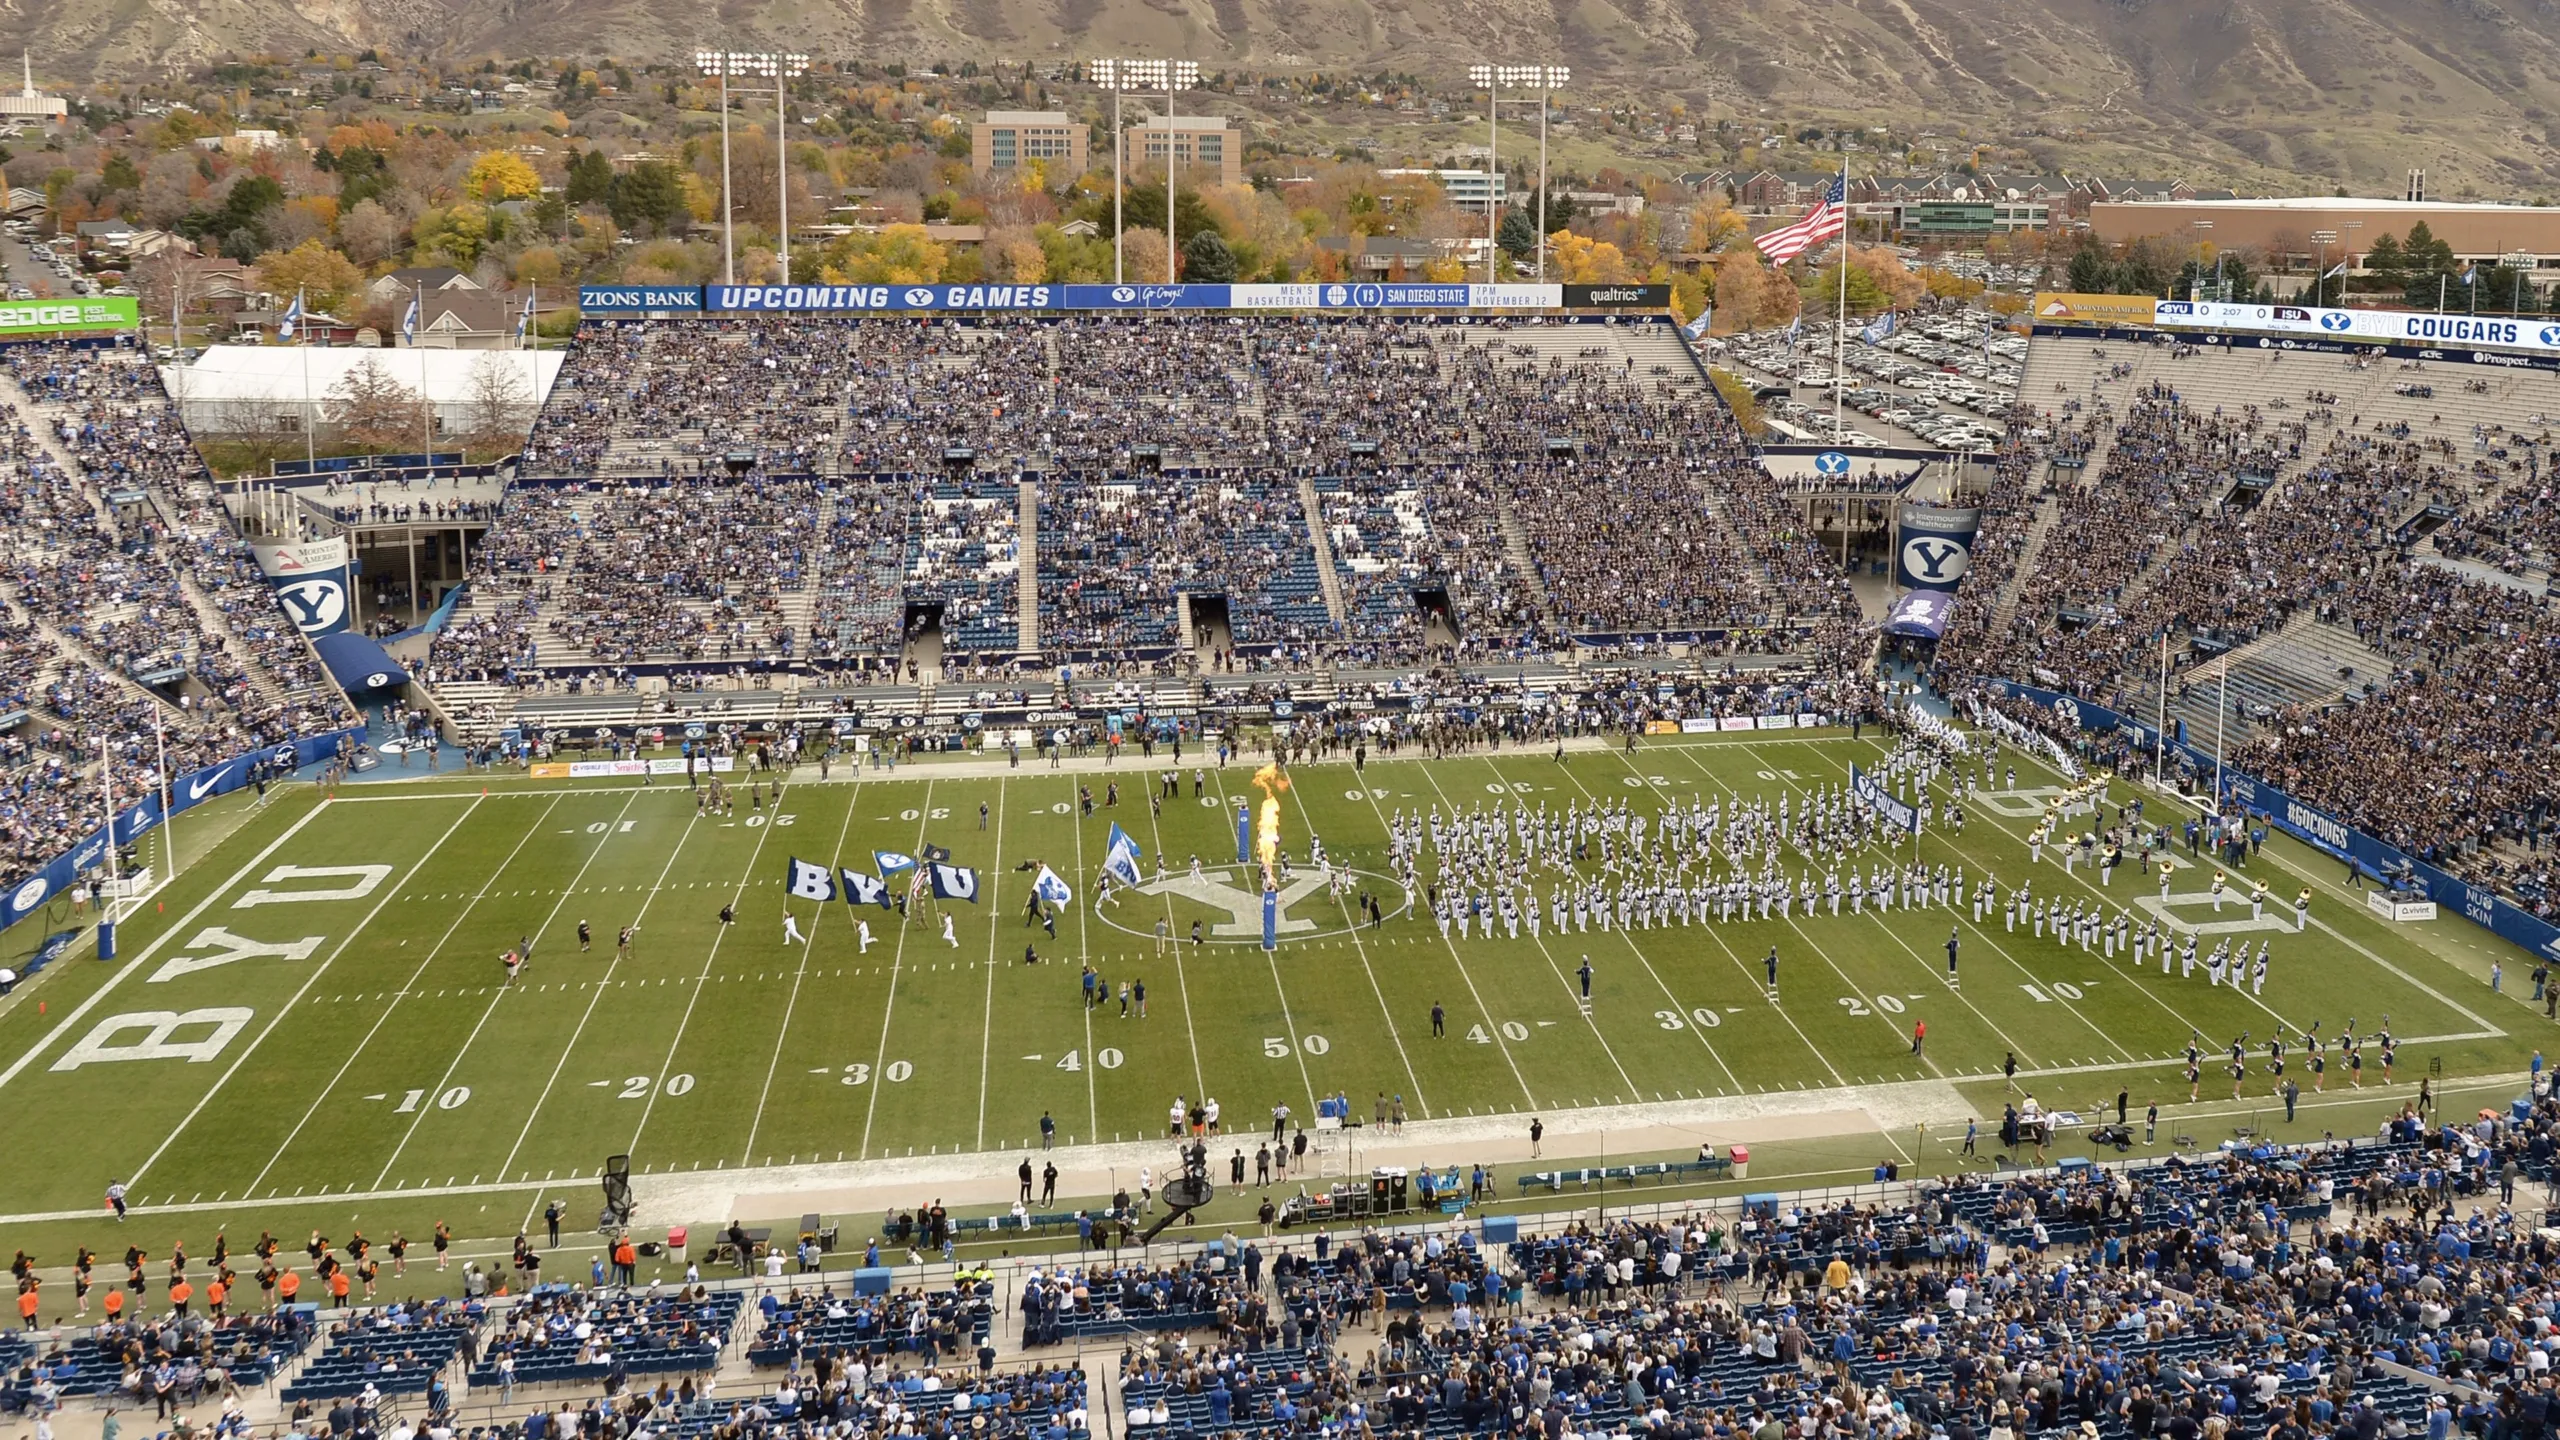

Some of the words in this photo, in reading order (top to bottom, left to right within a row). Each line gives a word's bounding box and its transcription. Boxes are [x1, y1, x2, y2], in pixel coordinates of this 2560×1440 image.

[1281, 286, 1313, 295] MEN'S
[1362, 290, 1374, 303] VS
[1387, 290, 1407, 303] SAN
[1408, 290, 1435, 303] DIEGO
[1437, 289, 1465, 303] STATE
[1476, 286, 1496, 296] 7PM
[582, 292, 640, 306] ZIONS
[645, 291, 697, 306] BANK
[722, 287, 888, 308] UPCOMING
[947, 287, 1049, 307] GAMES
[1247, 297, 1313, 306] BASKETBALL
[1476, 296, 1530, 306] NOVEMBER
[1536, 296, 1547, 306] 12
[2165, 304, 2188, 314] BYU
[2200, 305, 2210, 316] 0
[2222, 307, 2242, 316] 2:07
[2257, 308, 2267, 318] 0
[2281, 309, 2302, 320] ISU
[2407, 317, 2518, 343] COUGARS
[2484, 352, 2532, 367] Prospect.
[1915, 511, 1973, 524] Intermountain
[1915, 519, 1955, 530] Healthcare
[1175, 707, 1197, 716] YOUNG
[1238, 704, 1270, 714] FOOTBALL
[923, 716, 933, 726] GO
[934, 715, 955, 725] COUGS
[1042, 711, 1078, 721] FOOTBALL
[2287, 801, 2348, 850] #GOCOUGS
[792, 860, 836, 900] B
[937, 865, 975, 899] U
[2409, 905, 2430, 914] vivint
[2466, 903, 2493, 928] SKIN
[48, 865, 393, 1072] BYU
